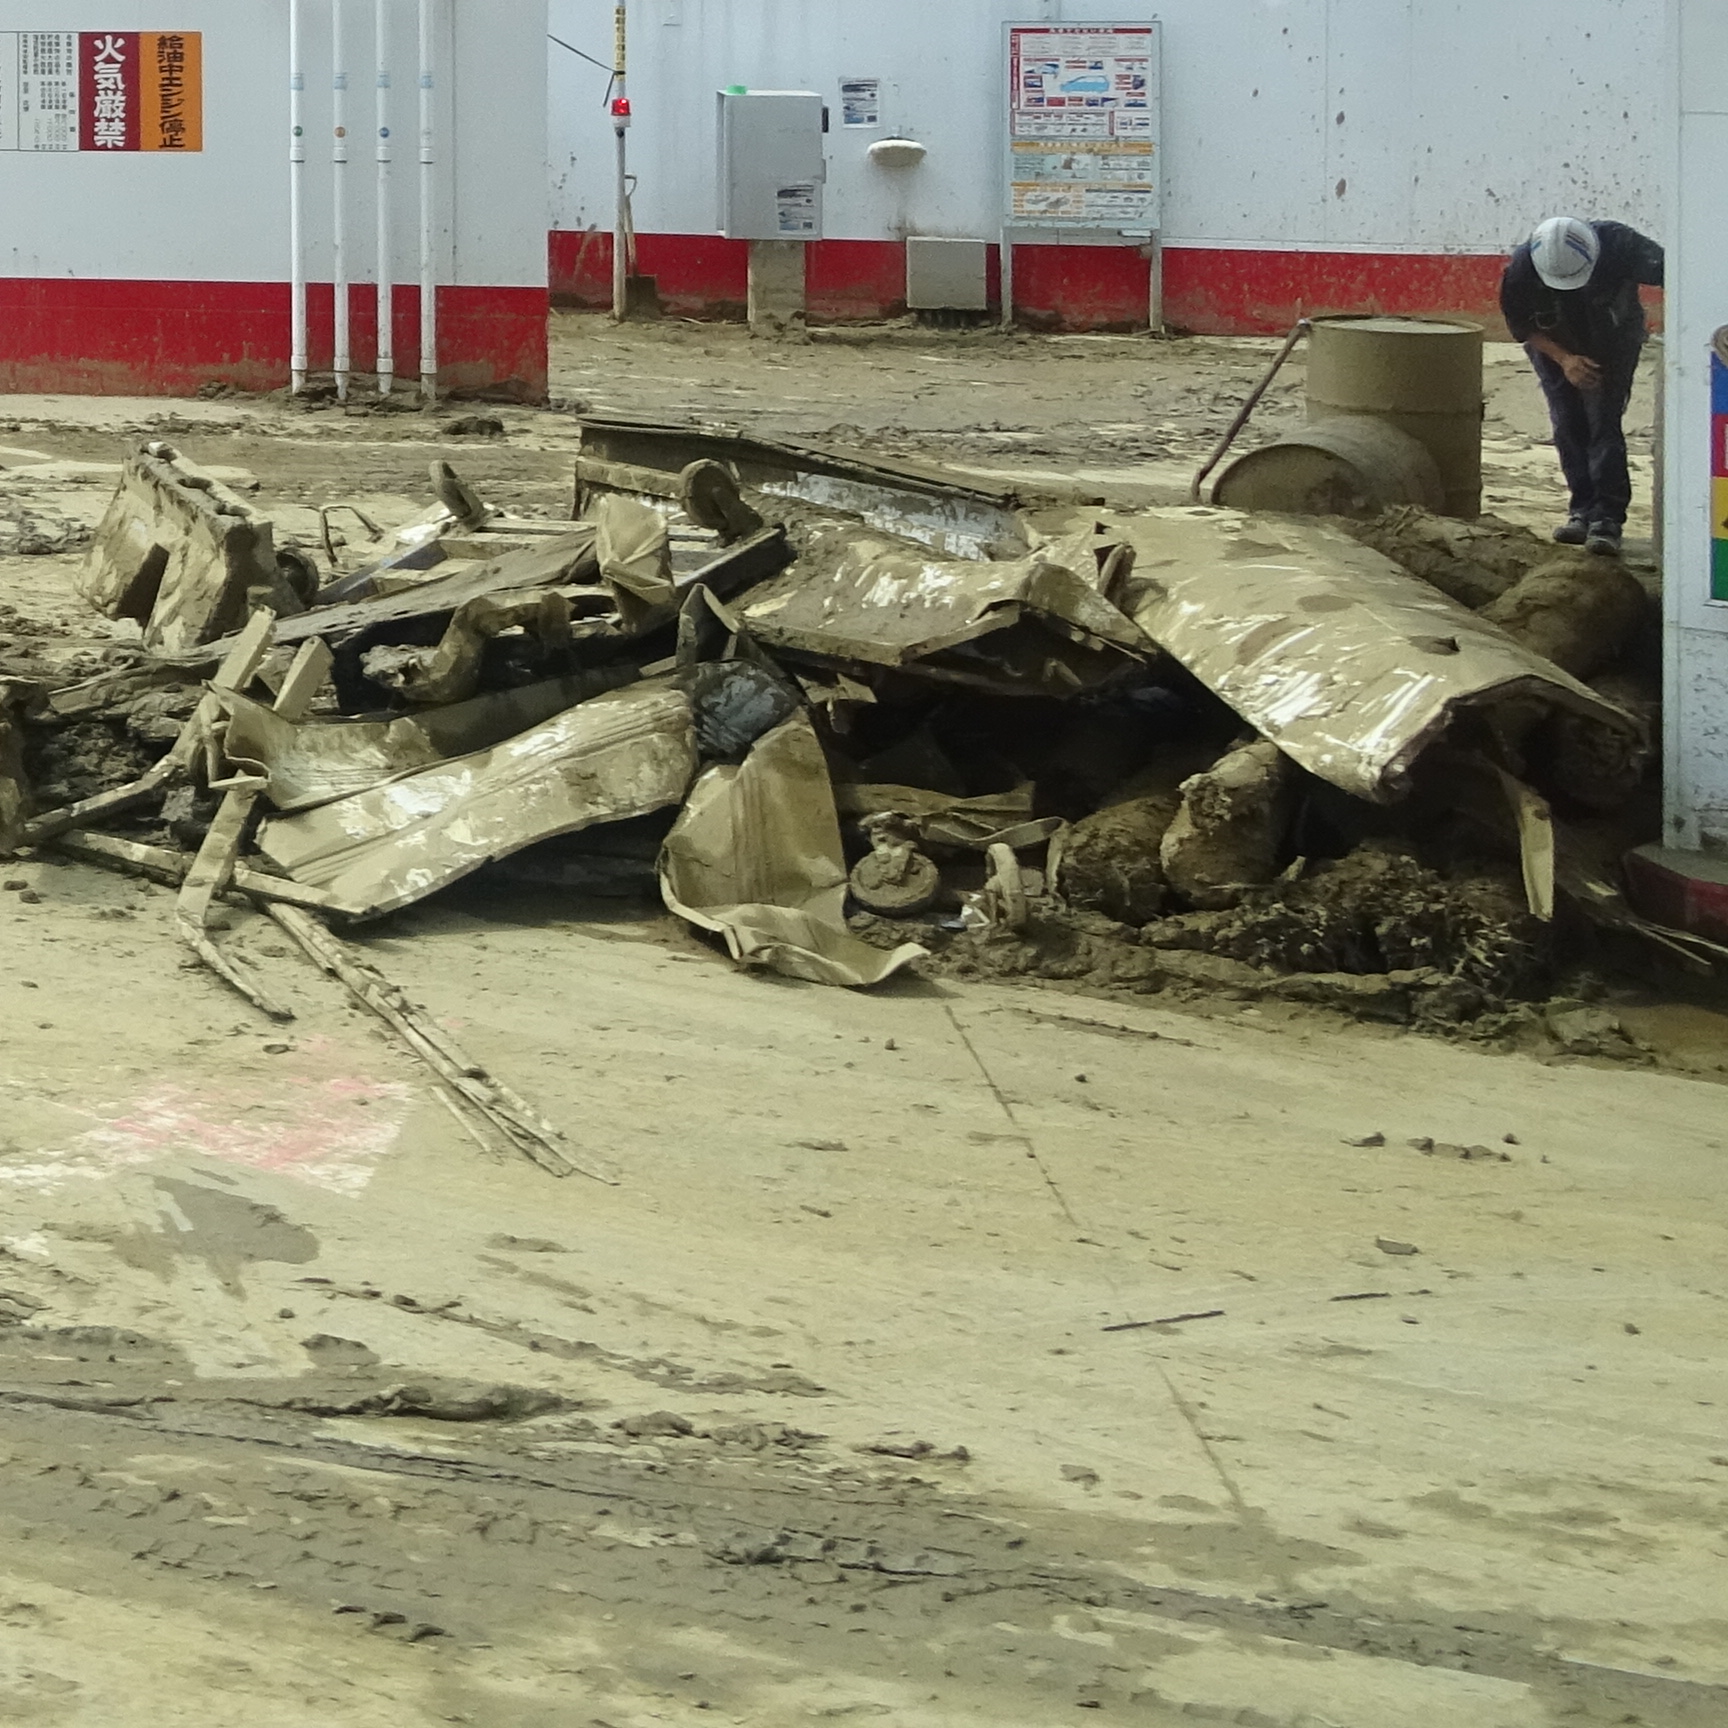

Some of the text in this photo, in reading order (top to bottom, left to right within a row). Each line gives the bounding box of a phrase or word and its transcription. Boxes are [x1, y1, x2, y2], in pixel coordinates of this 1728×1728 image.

[93, 34, 127, 149] 火気厳禁
[157, 35, 186, 148] 給油中エンジン停止
